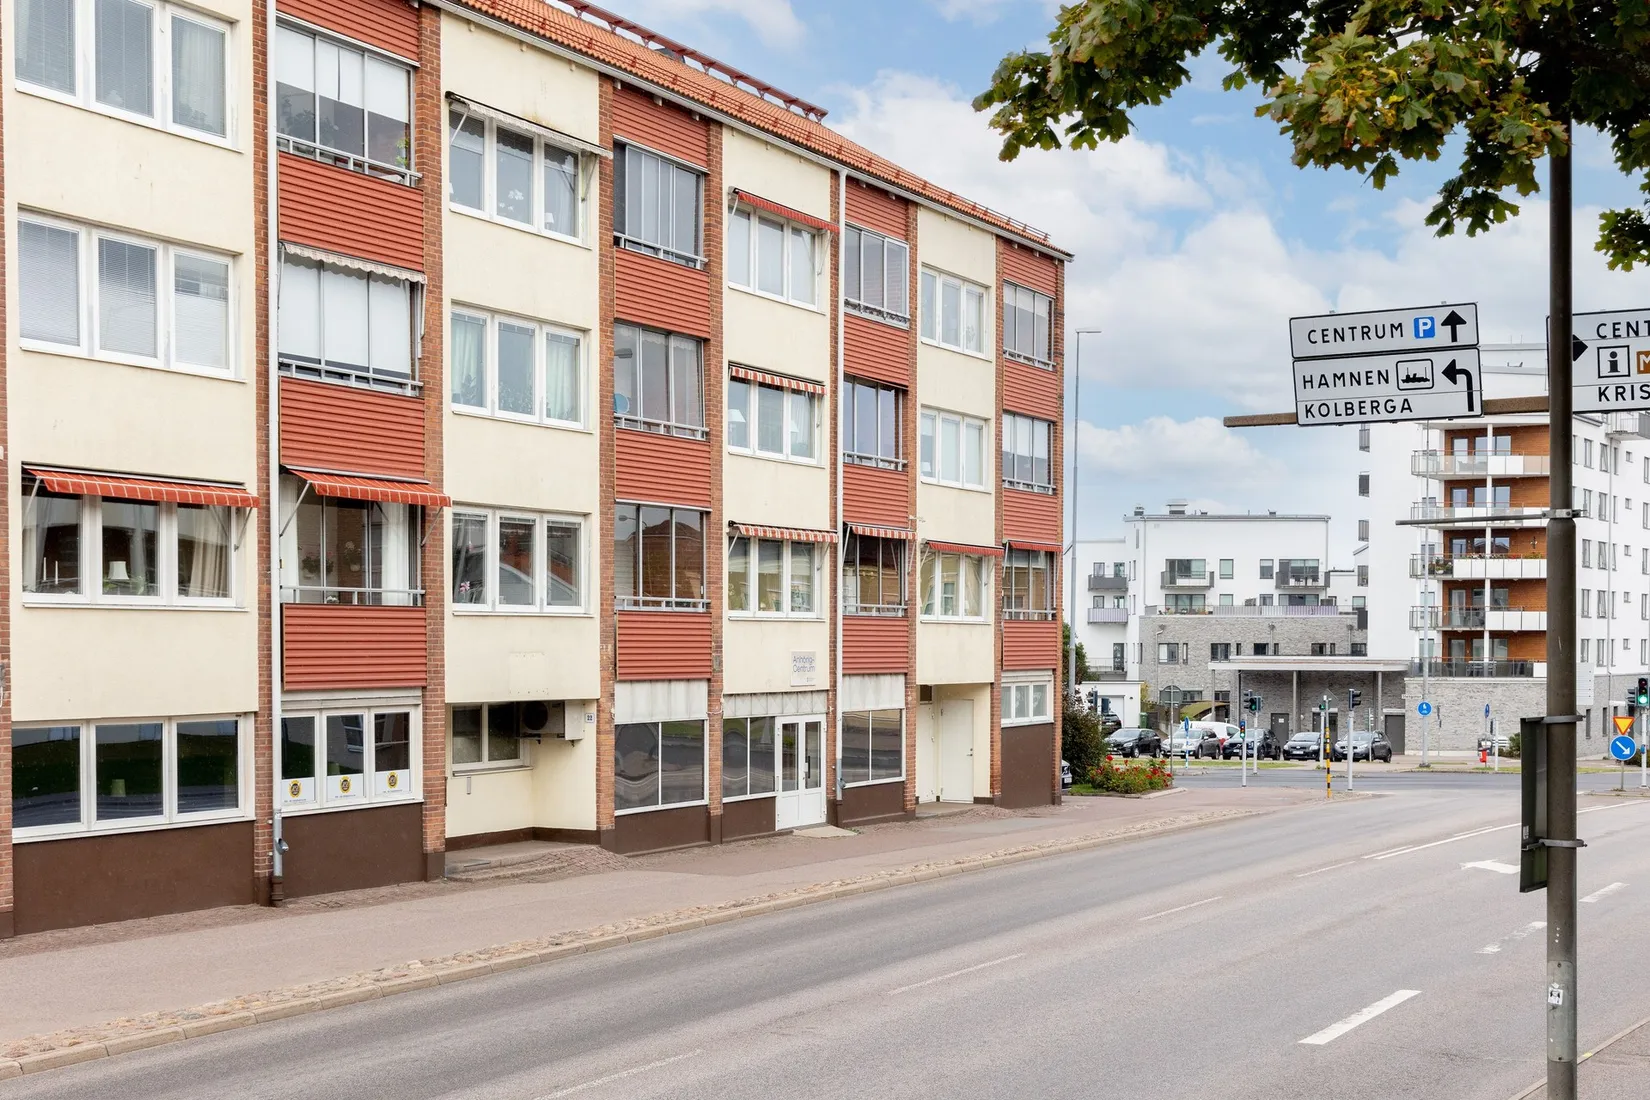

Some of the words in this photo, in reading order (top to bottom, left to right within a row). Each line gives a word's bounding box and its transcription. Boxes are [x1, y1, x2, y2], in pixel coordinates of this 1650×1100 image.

[1308, 322, 1403, 344] CENTRUM
[1418, 318, 1432, 337] P
[1303, 369, 1390, 390] HAMNEN
[1598, 384, 1650, 402] KRIS
[1305, 398, 1413, 419] KOLBERGA
